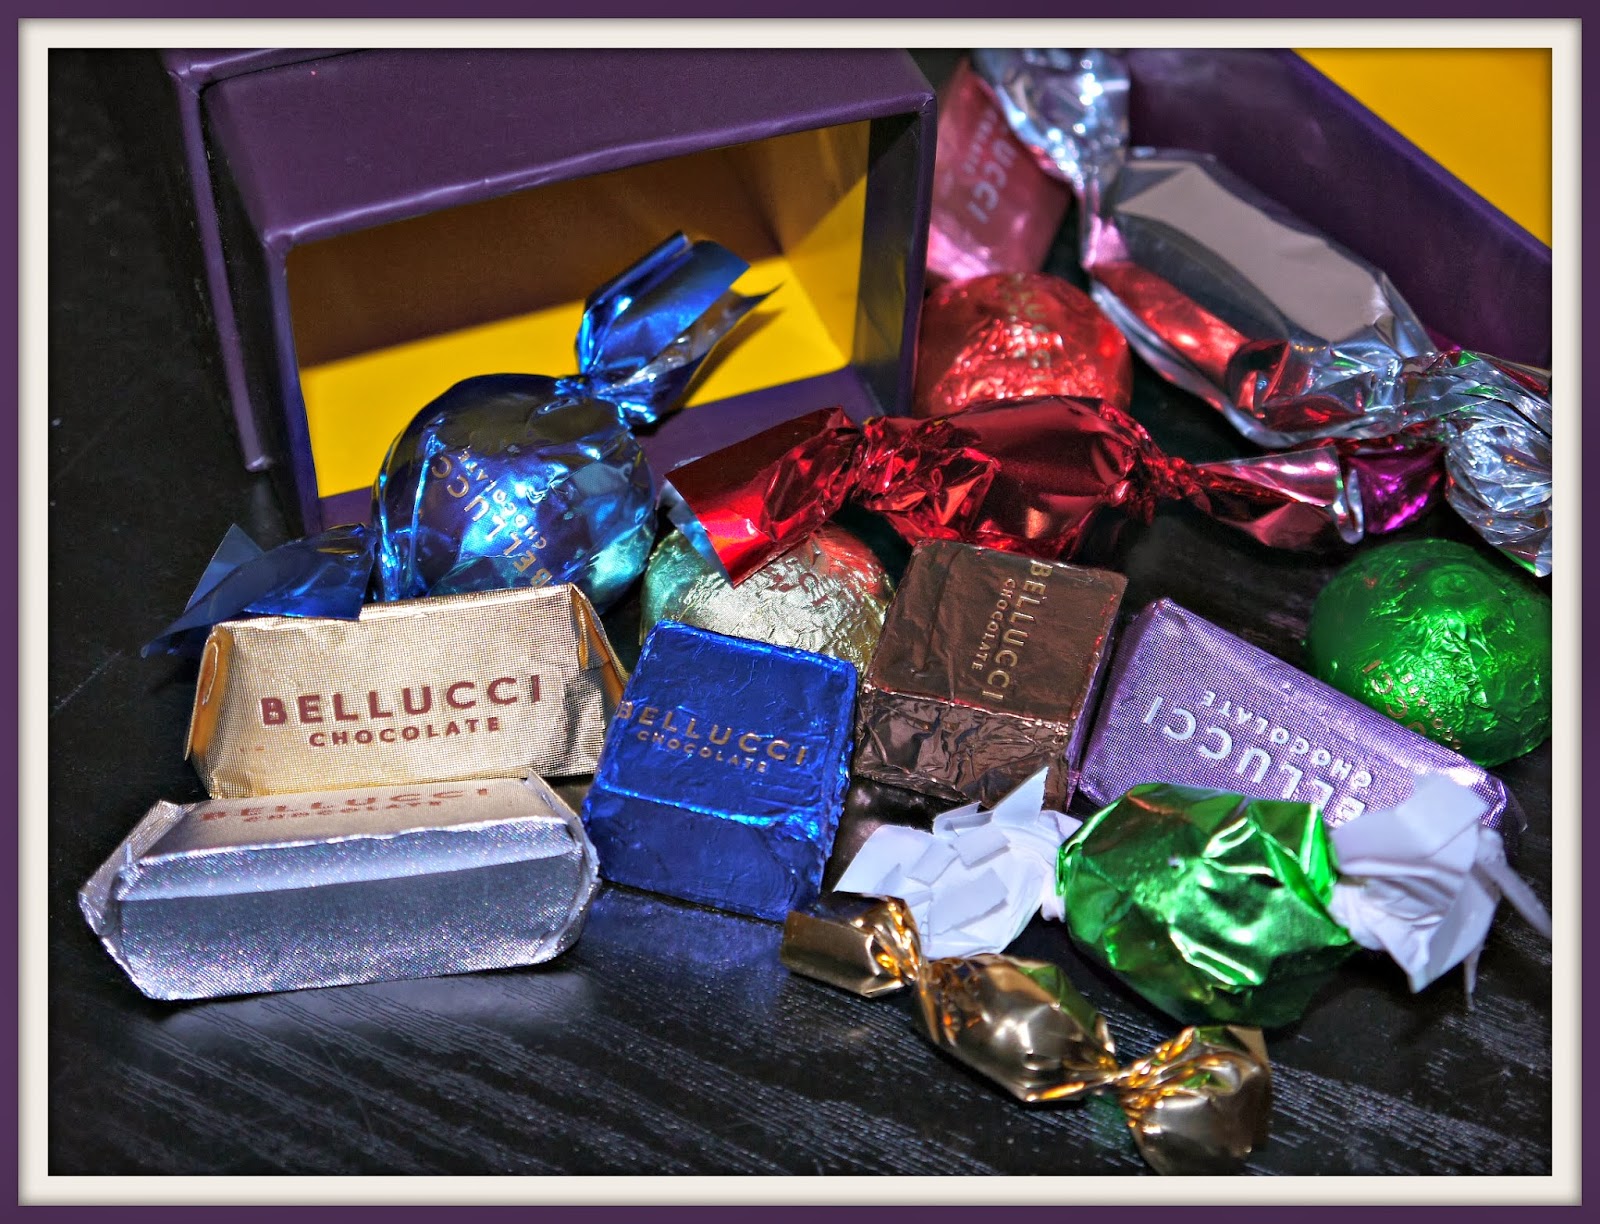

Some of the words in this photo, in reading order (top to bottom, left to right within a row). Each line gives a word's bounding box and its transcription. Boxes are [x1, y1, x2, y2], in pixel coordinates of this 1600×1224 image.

[431, 455, 553, 588] BELLUCC
[971, 577, 1017, 671] CHOCOLATE
[981, 559, 1054, 701] BELLUCCI
[261, 674, 541, 726] BELLUCCI
[308, 716, 501, 747] CHOCOLATE
[616, 700, 808, 766] BELLUCCI
[1201, 689, 1373, 789] CHOCOLATE
[636, 730, 769, 774] CHOCOLATE
[1142, 695, 1366, 828] ELLUCCI
